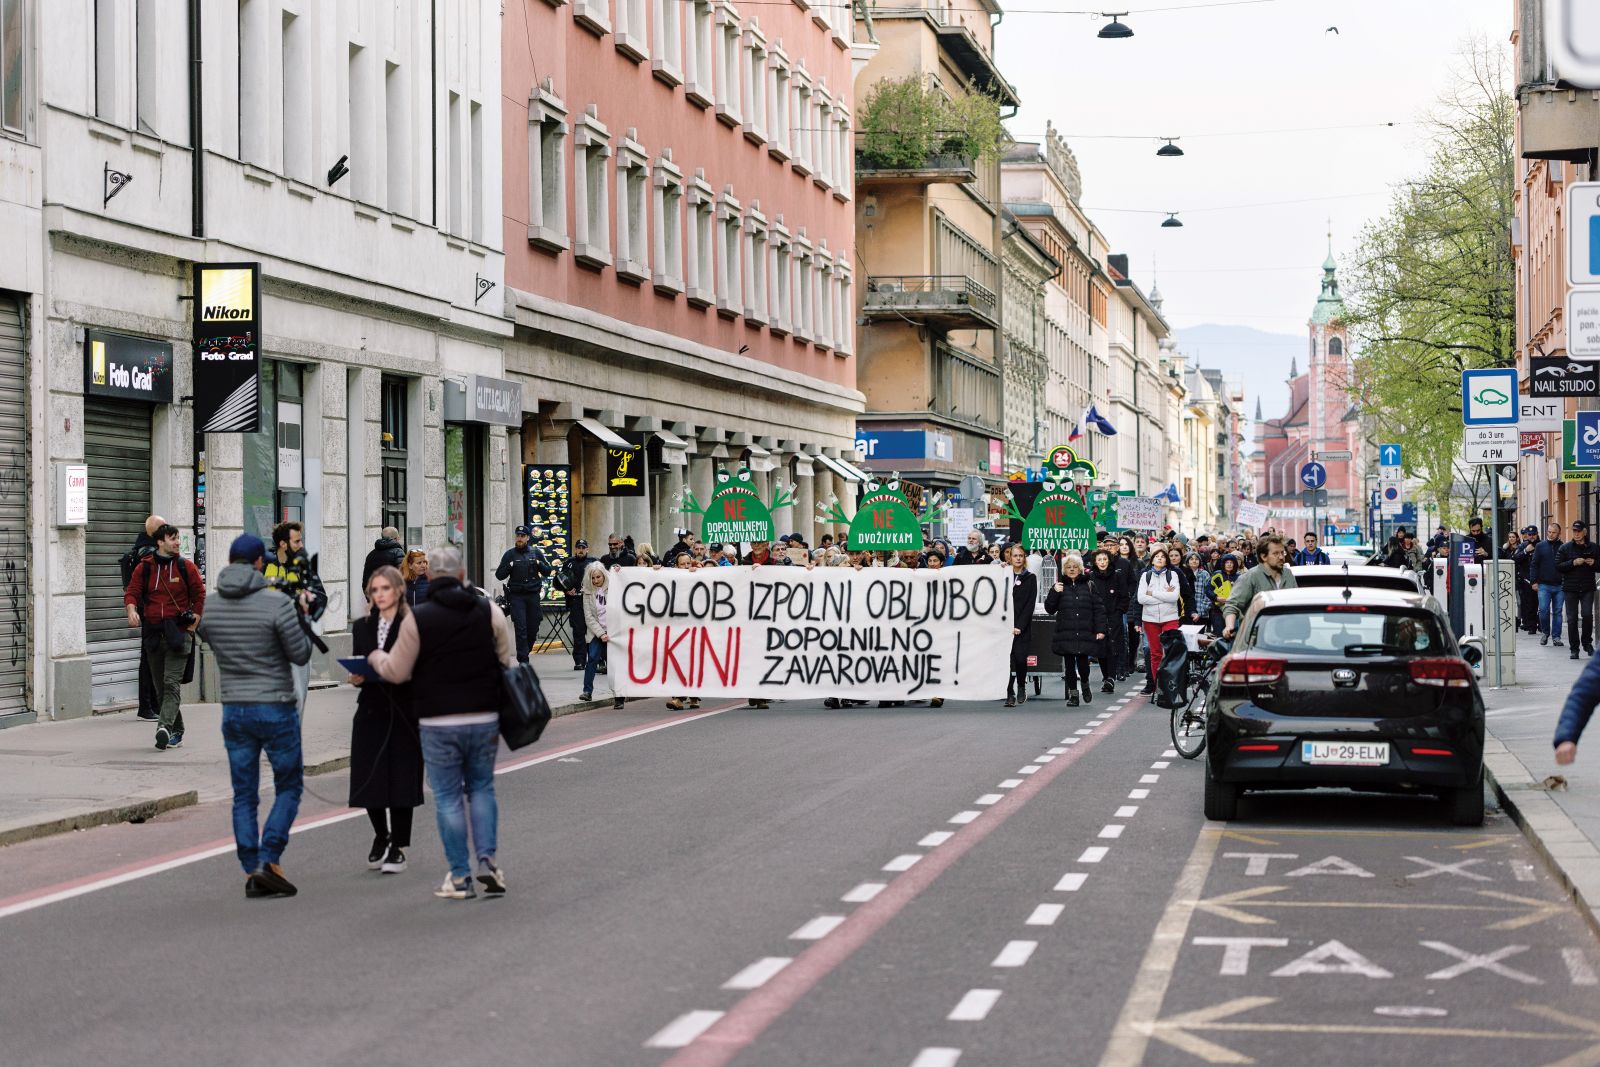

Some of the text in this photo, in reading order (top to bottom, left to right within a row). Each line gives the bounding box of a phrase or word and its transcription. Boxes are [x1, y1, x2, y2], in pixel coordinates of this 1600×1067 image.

[203, 305, 251, 320] Nikon
[201, 350, 254, 361] Foto Grad
[109, 362, 152, 391] Foto Grad
[1534, 379, 1596, 393] NAIL STUDIO
[1478, 431, 1487, 439] do
[1488, 431, 1493, 439] 3
[1055, 452, 1069, 461] 24
[1482, 449, 1503, 459] 4 PM
[724, 499, 746, 520] NE
[1045, 505, 1067, 526] NE
[707, 521, 768, 532] DOPOLNILNEMU
[873, 509, 894, 529] NE
[708, 531, 767, 543] ZAVAROVANJU
[858, 531, 913, 544] DVOŽIVKAM
[1028, 528, 1090, 539] PRIVATIZACIJI
[1029, 539, 1089, 550] ZDRAVSTVA
[622, 576, 1009, 628] GOLOB IZPOLNI OBLJUBO!
[766, 627, 933, 652] DOPOLNILNO
[628, 625, 741, 688] UKINI
[759, 653, 942, 695] ZAVAROVANJE
[1314, 745, 1386, 760] LJ 29-ELM
[1222, 852, 1537, 882] TAXI
[1192, 937, 1599, 986] TAXI
